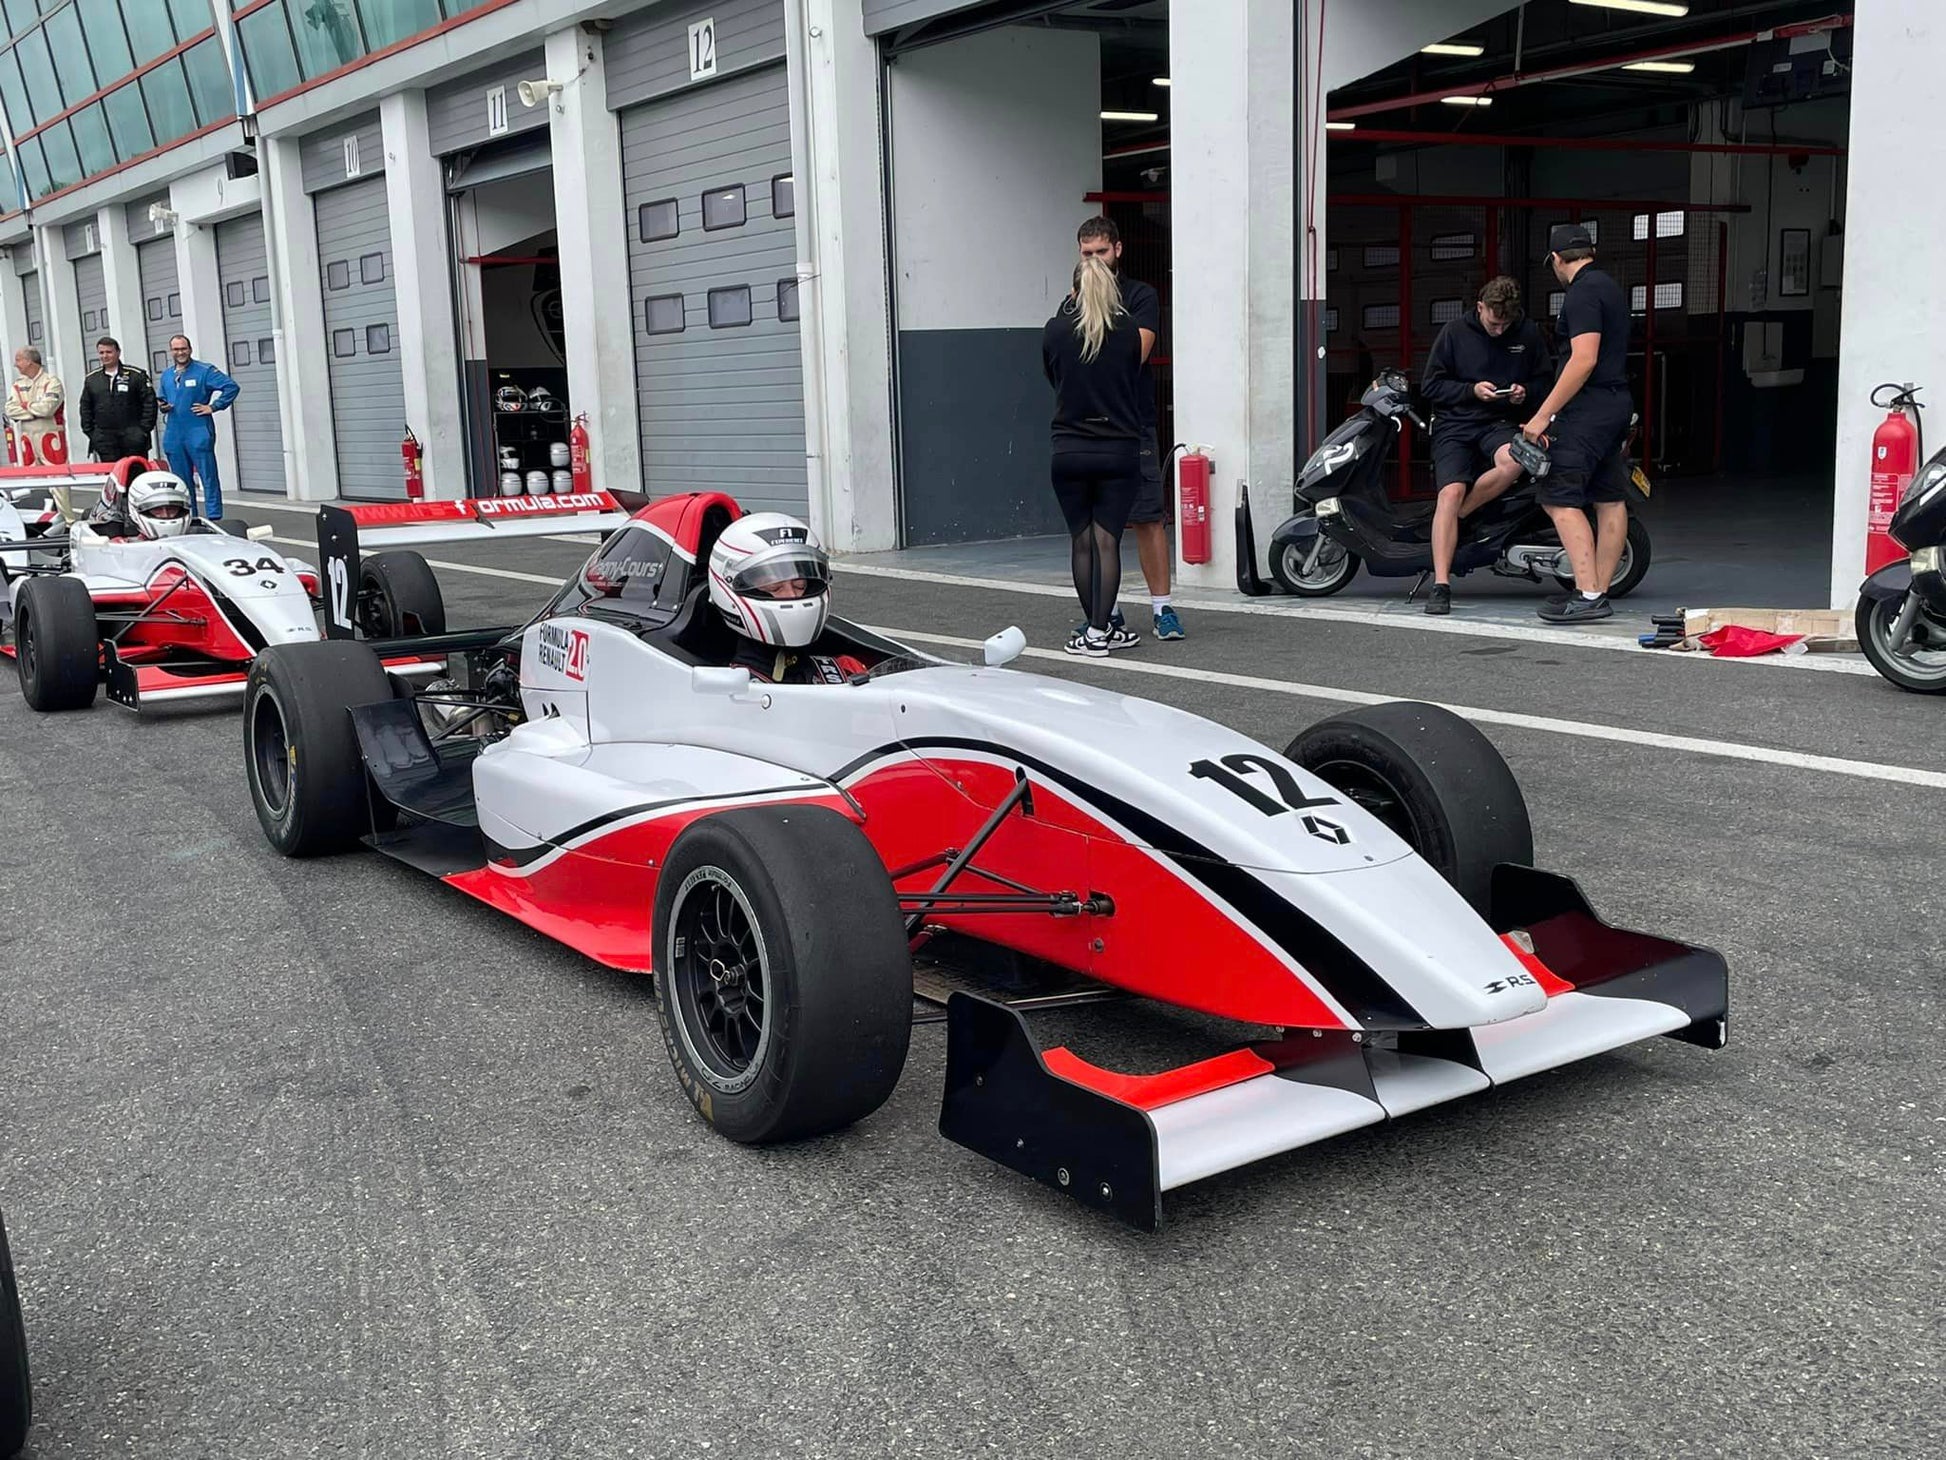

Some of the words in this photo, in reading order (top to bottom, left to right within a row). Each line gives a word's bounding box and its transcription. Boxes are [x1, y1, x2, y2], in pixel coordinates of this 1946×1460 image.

[692, 24, 713, 73] 12
[492, 92, 505, 131] 11
[346, 140, 358, 173] 10
[217, 178, 224, 206] 9
[779, 528, 793, 538] F1
[223, 557, 284, 577] 34
[328, 556, 352, 629] 12
[1188, 754, 1343, 817] 12
[1508, 975, 1535, 989] RS
